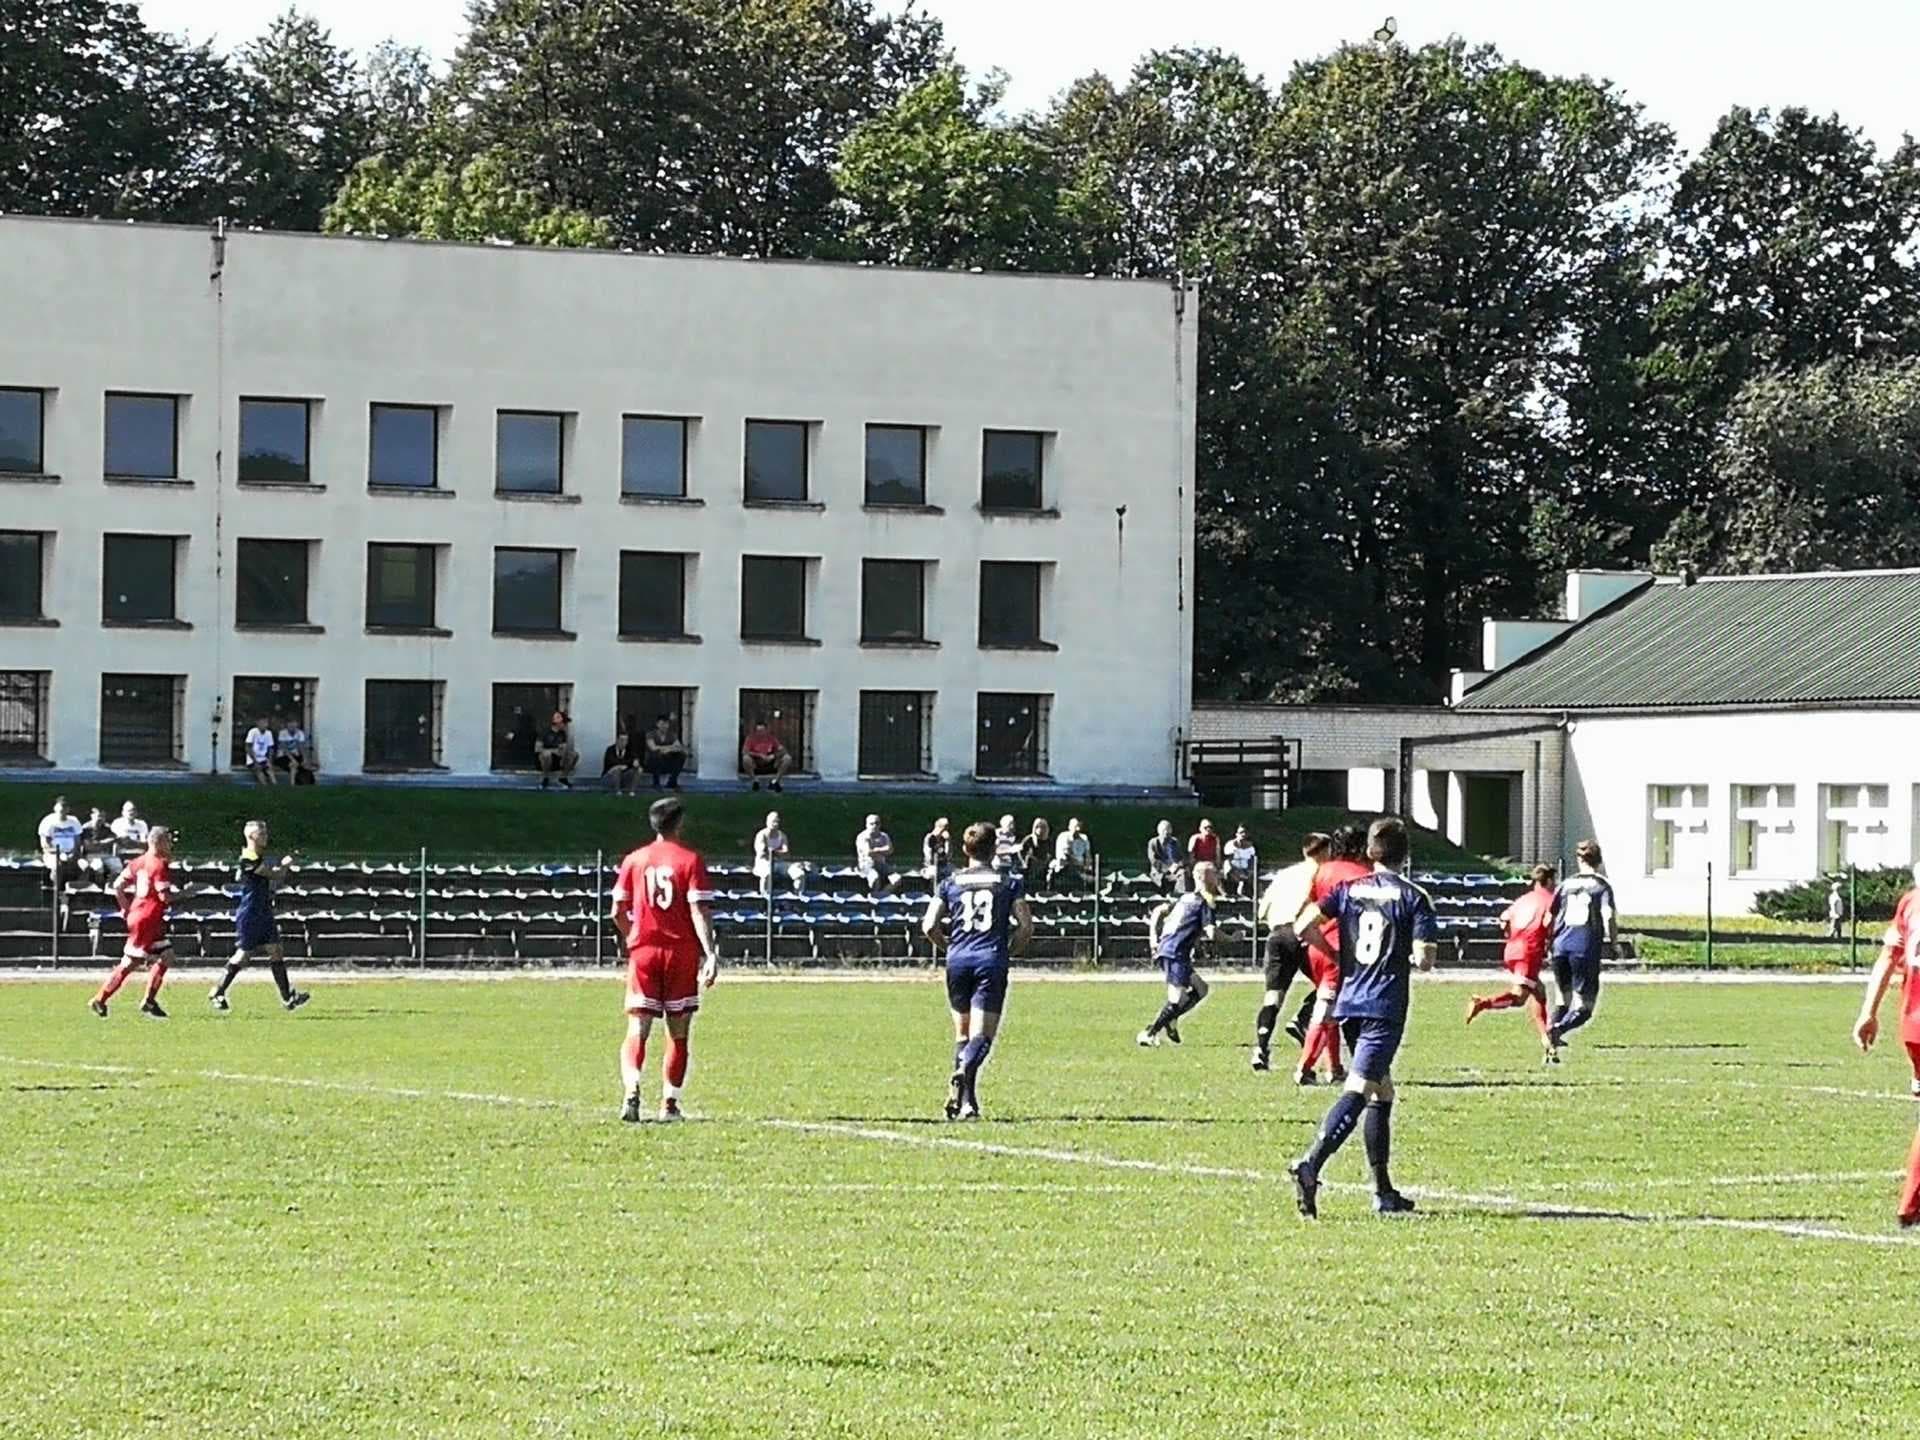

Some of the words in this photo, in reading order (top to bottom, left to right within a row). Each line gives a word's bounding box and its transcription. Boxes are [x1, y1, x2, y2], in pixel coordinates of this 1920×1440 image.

[644, 866, 674, 910] 15
[960, 889, 994, 932] 13
[1355, 911, 1384, 965] 8
